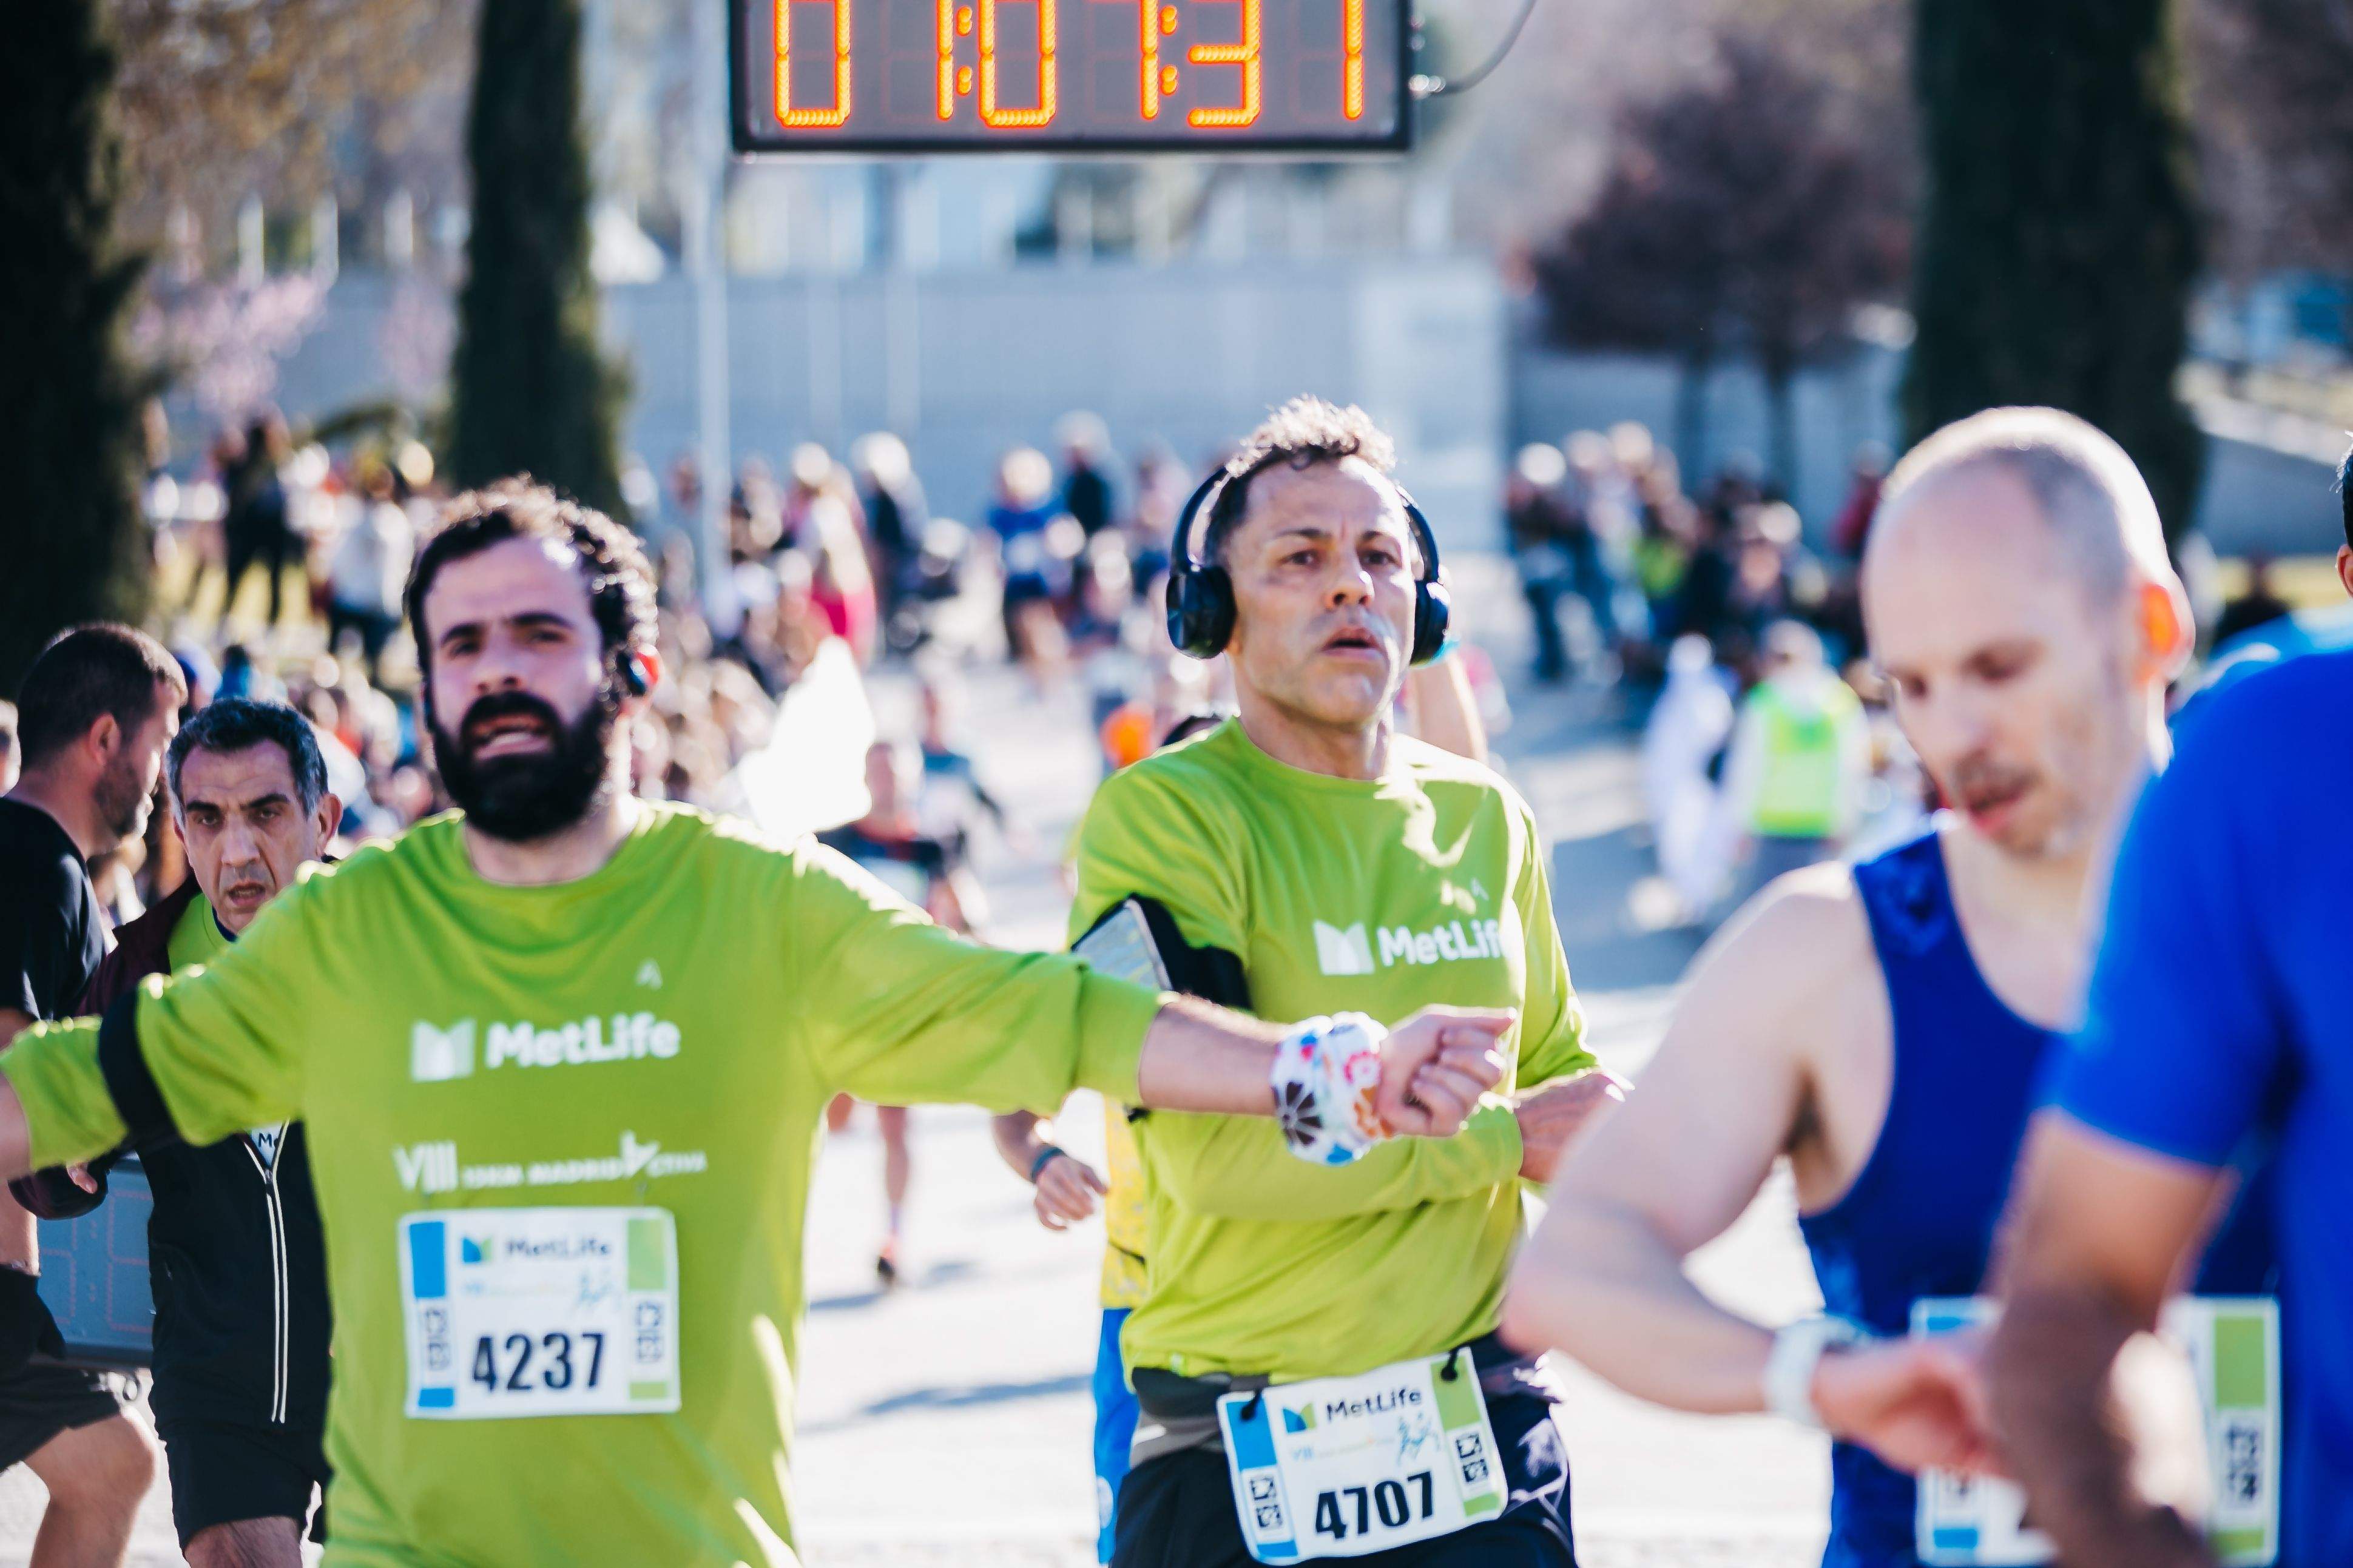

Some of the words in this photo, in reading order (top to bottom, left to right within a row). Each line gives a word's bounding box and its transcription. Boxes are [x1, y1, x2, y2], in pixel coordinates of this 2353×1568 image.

[1376, 918, 1511, 967] MetLif
[485, 1011, 681, 1070] MetLife
[258, 1132, 279, 1148] M
[473, 1332, 606, 1393] 4237
[1325, 1386, 1424, 1423] MetLife
[1314, 1470, 1434, 1541] 4707
